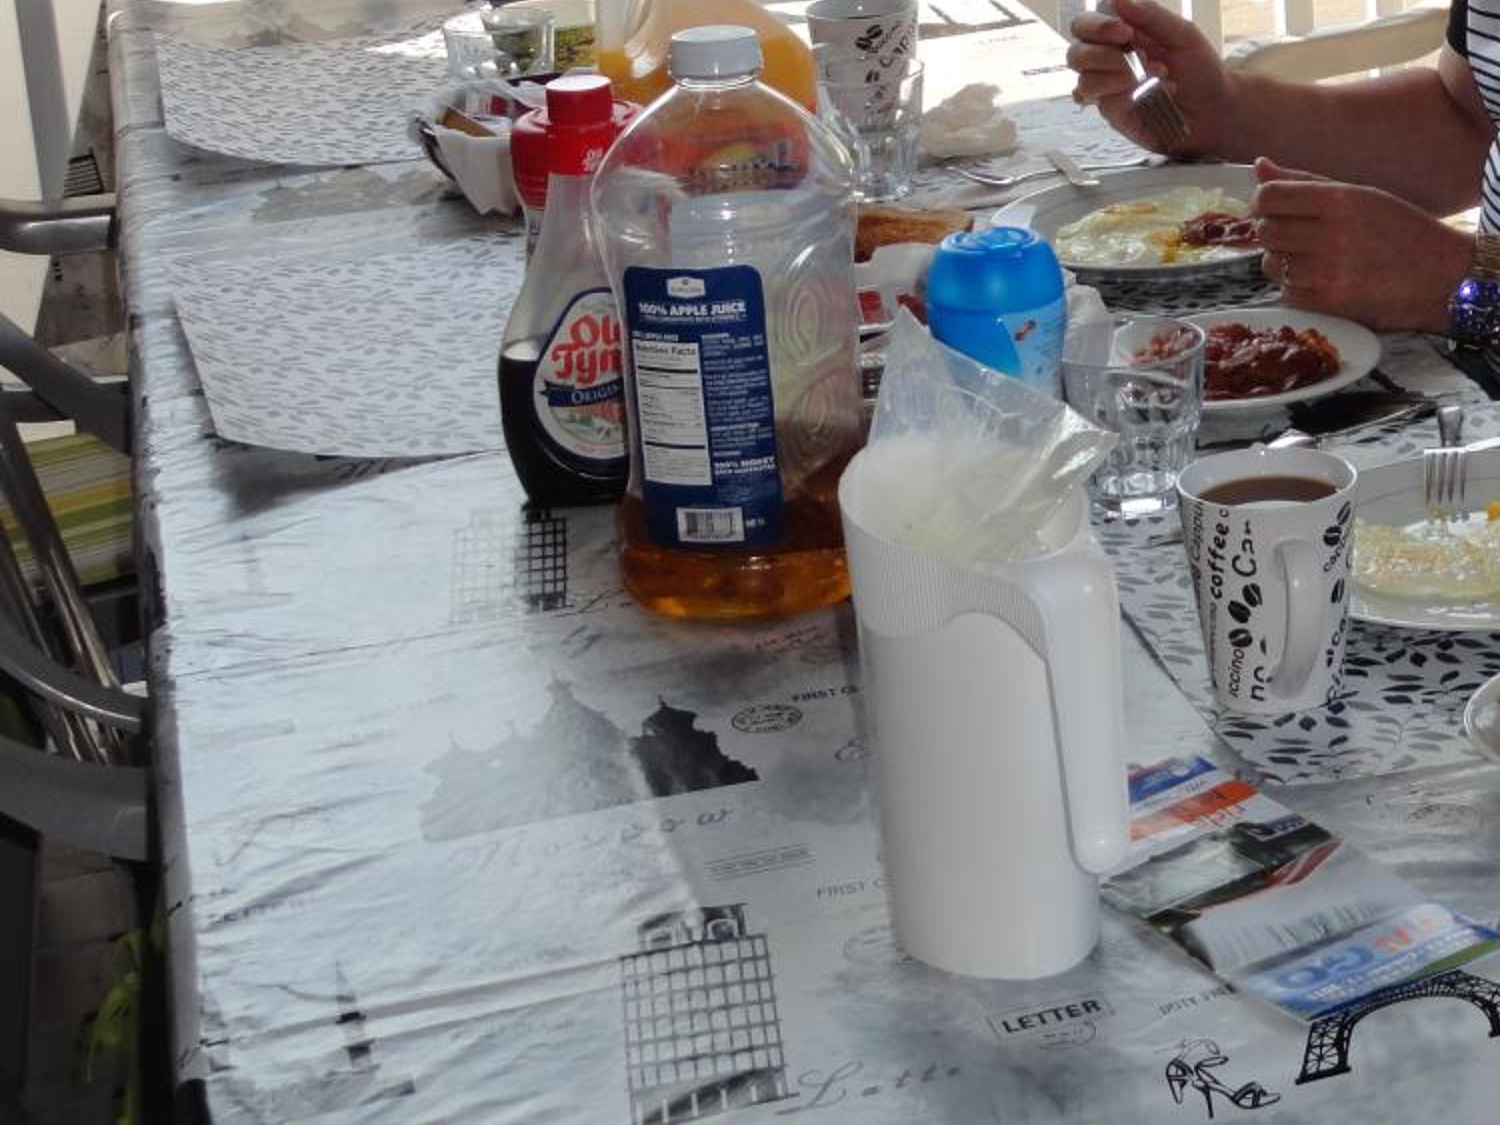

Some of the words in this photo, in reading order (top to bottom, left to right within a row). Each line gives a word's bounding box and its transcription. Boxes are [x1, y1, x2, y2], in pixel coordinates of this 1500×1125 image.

[669, 303, 709, 316] APPLE
[711, 299, 747, 315] JUICE
[1207, 522, 1230, 599] coffee
[1001, 999, 1102, 1034] LETTER
